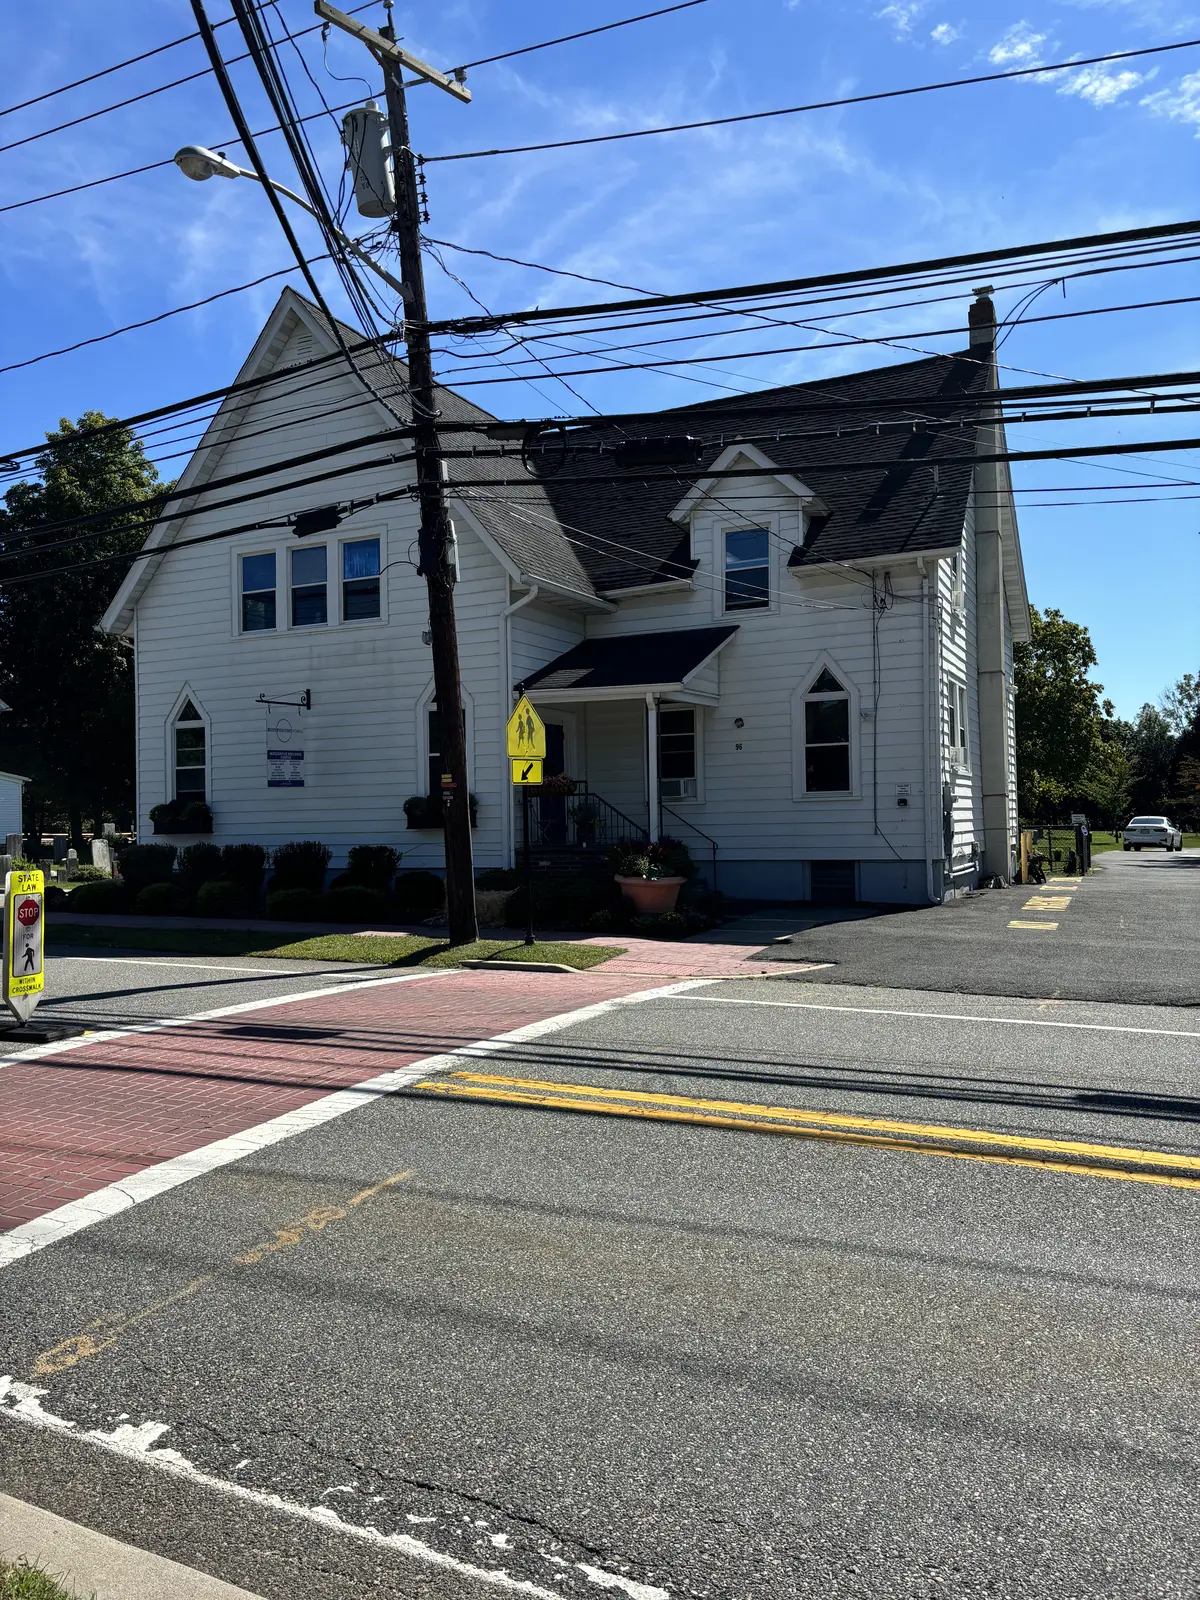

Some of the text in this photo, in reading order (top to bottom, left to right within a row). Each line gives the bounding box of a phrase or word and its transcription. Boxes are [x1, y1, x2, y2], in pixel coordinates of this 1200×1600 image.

[18, 873, 39, 883] STATE
[22, 883, 37, 892] LAW
[19, 907, 39, 919] STOP
[22, 932, 34, 941] FOR
[18, 976, 36, 985] WITHIN
[11, 983, 41, 994] CROSSWALK
